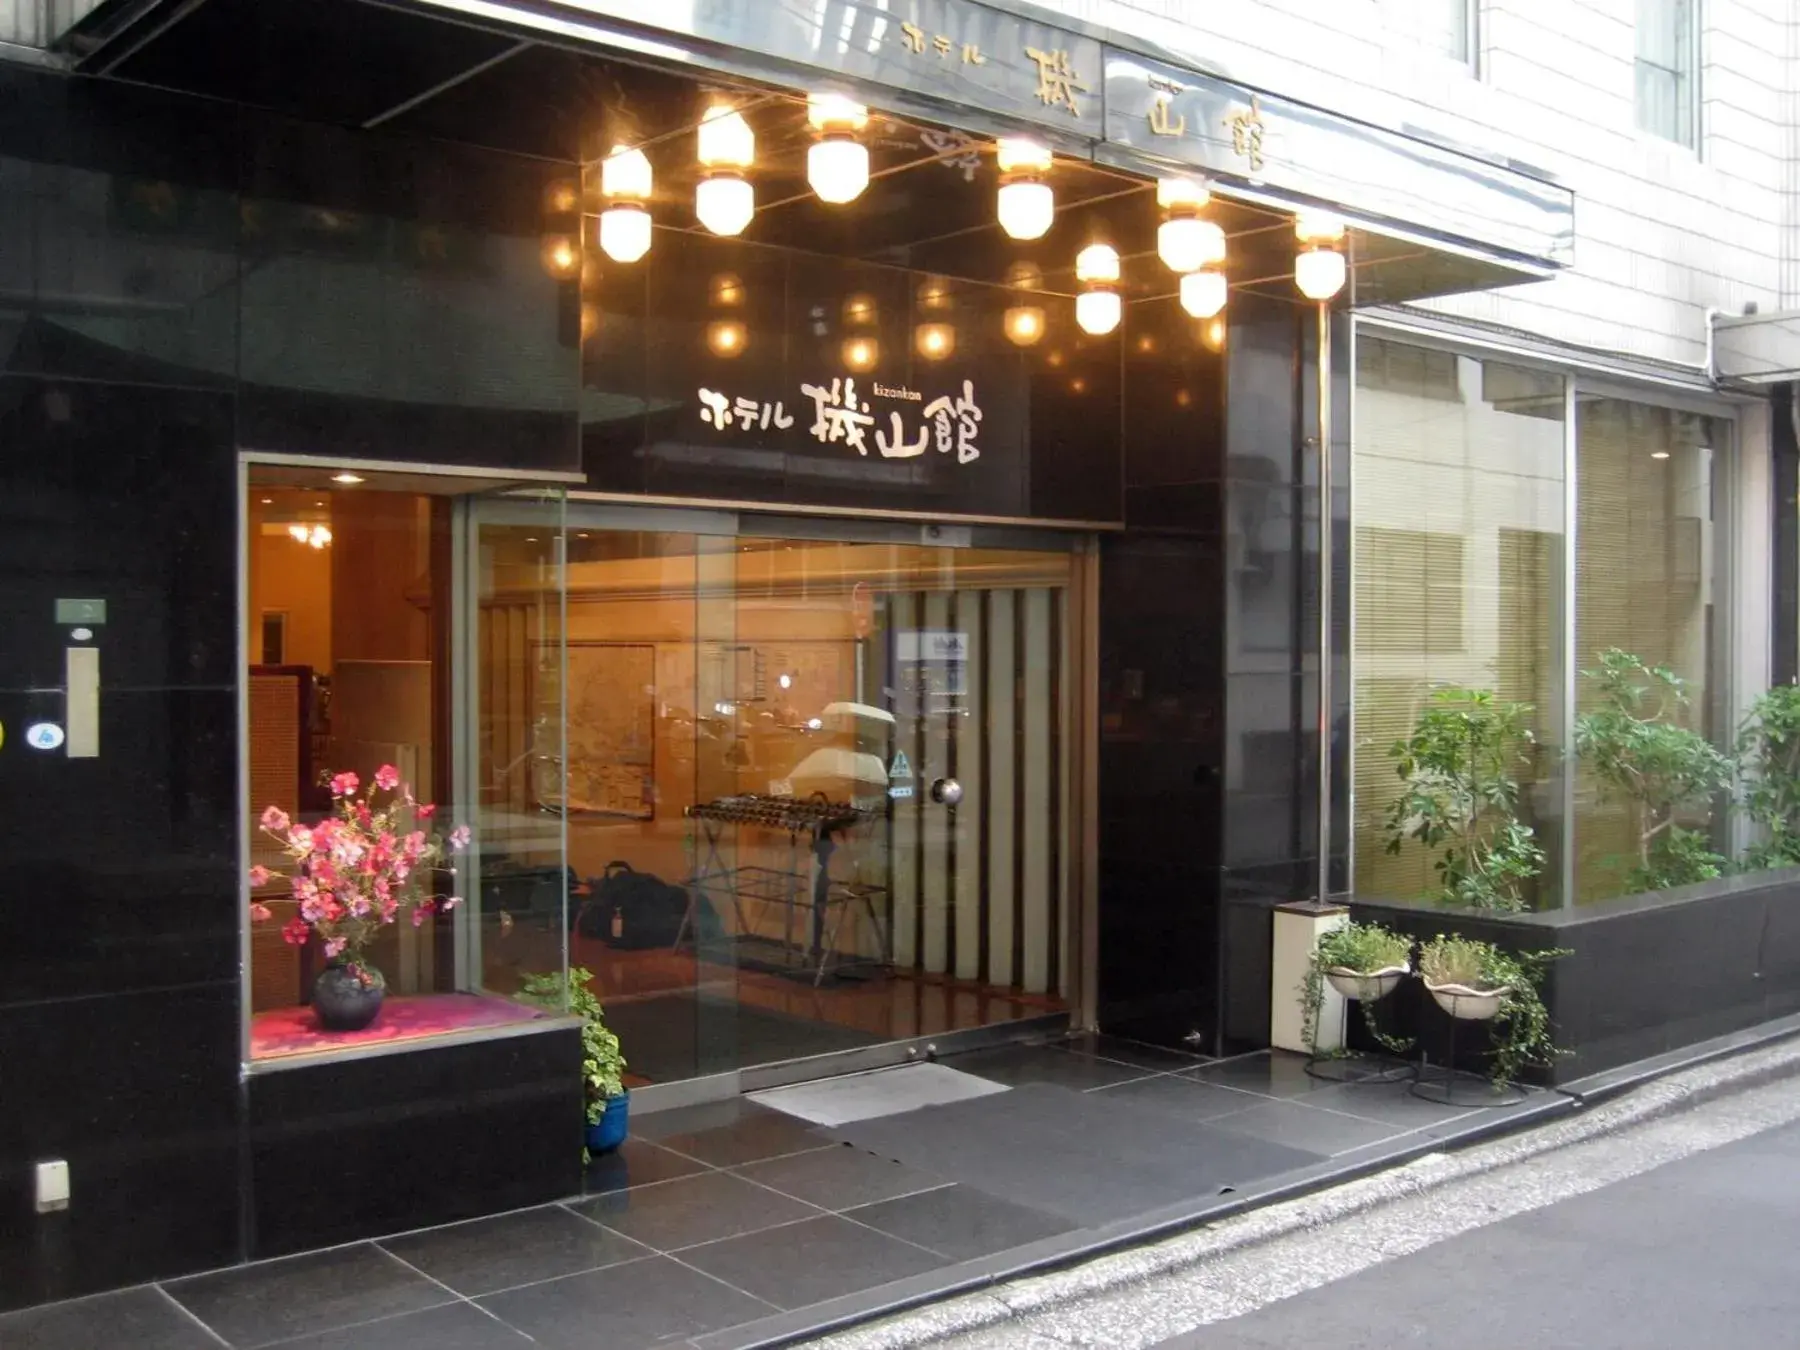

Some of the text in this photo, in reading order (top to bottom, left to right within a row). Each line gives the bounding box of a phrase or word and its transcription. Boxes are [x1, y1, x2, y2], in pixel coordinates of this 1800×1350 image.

[901, 20, 986, 66] ホテル
[698, 387, 794, 431] ホテル
[873, 382, 922, 402] kizankan
